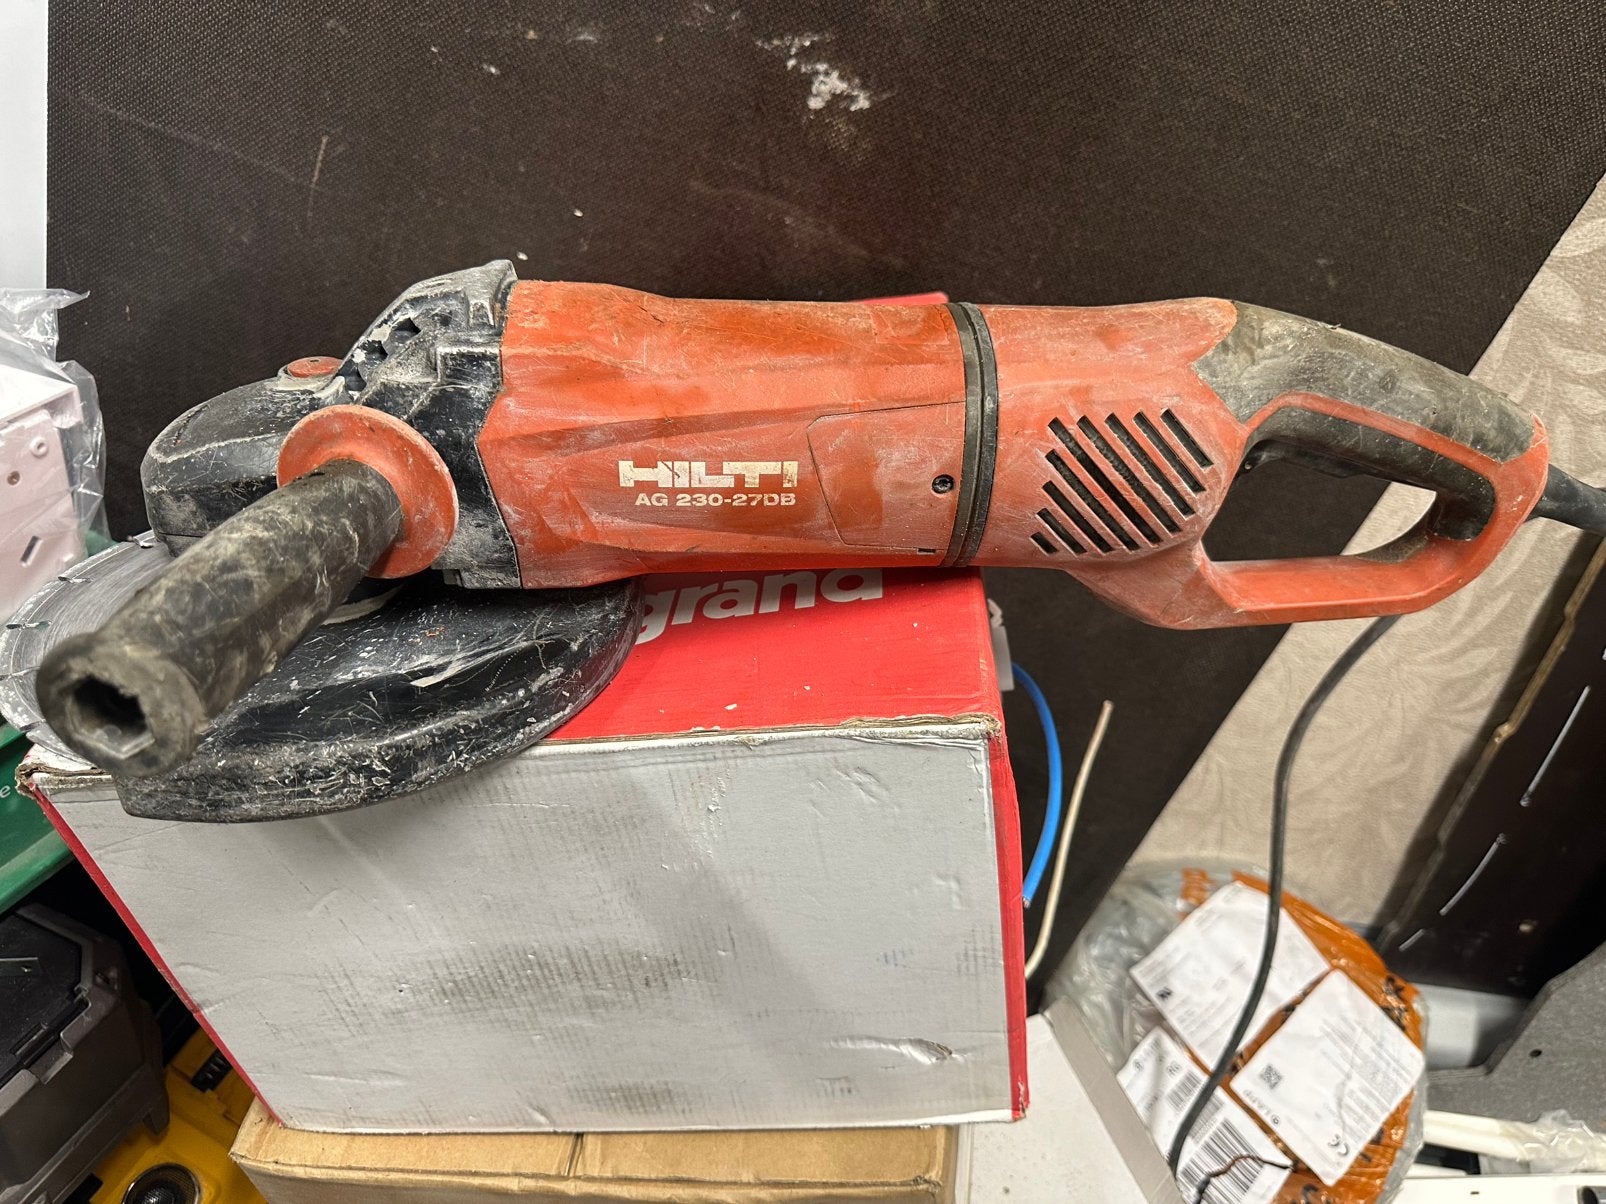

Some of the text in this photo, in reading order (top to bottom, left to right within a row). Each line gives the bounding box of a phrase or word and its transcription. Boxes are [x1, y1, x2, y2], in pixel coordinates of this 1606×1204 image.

[618, 460, 798, 488] HILTI
[635, 493, 796, 507] AG 230-27DB
